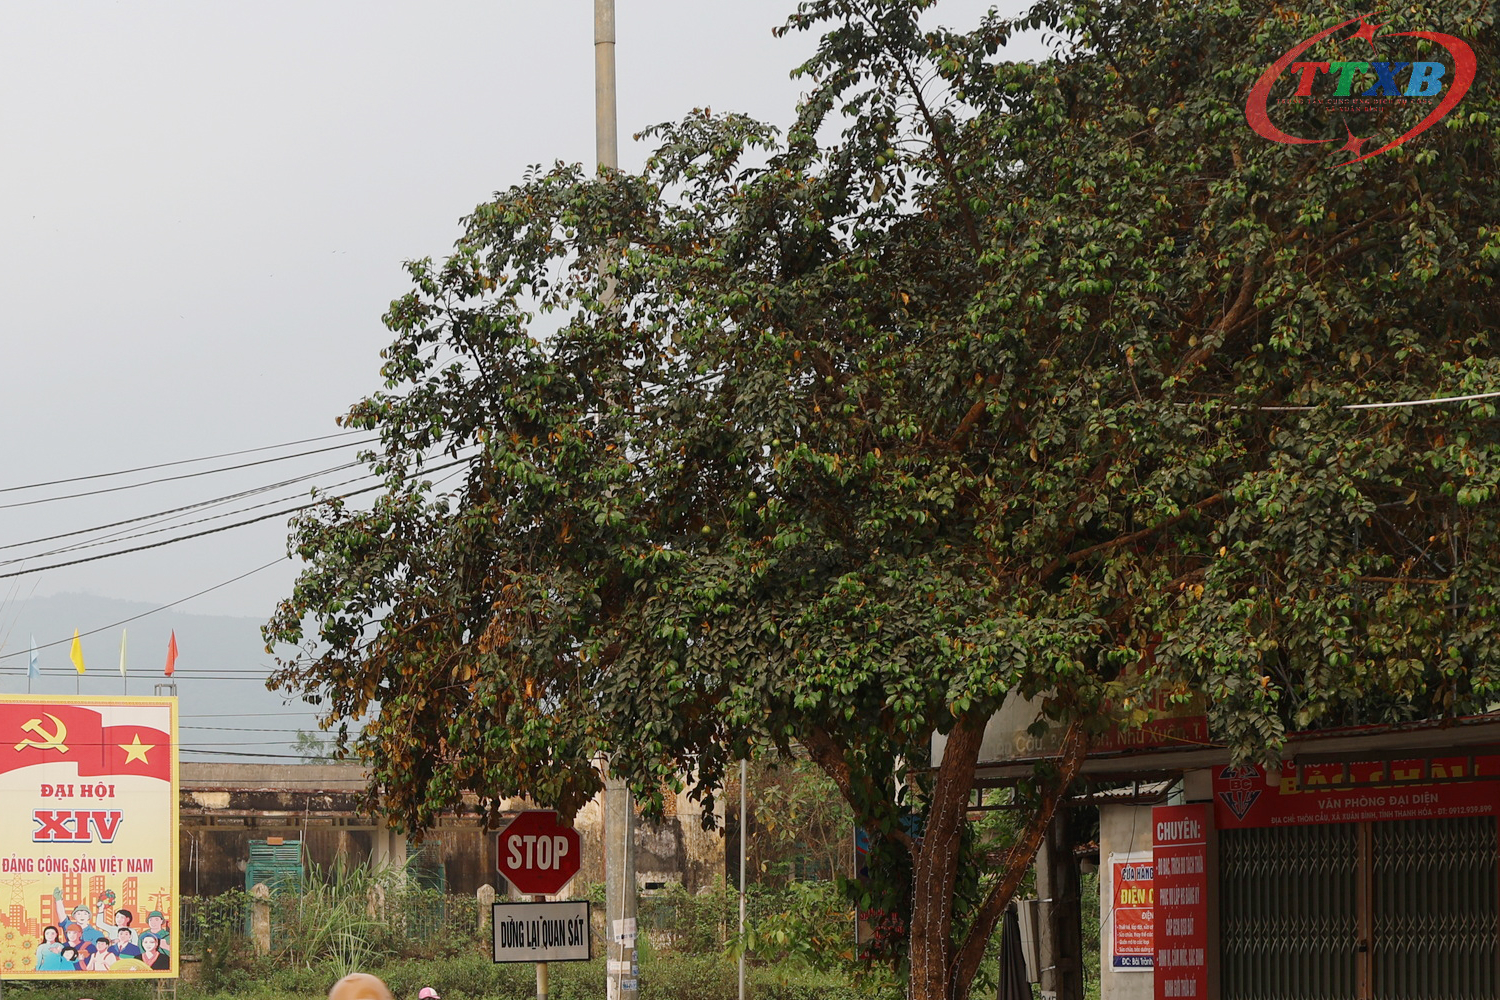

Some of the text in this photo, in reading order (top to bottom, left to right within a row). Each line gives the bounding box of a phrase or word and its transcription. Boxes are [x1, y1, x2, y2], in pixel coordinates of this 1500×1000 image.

[40, 782, 115, 801] ĐẠI HỘI
[1230, 779, 1252, 790] BC
[1279, 771, 1356, 795] BẢO
[1317, 791, 1439, 809] VĂN PHÒNG ĐẠI DIỆN
[33, 809, 122, 842] XIV
[1271, 816, 1282, 825] ĐỊA
[1297, 813, 1313, 823] THÔN
[1342, 811, 1359, 820] XUÂN
[1395, 809, 1416, 817] THANH
[1418, 807, 1432, 816] HÓA
[1157, 817, 1201, 841] CHUYÊN:
[507, 834, 569, 870] STOP
[2, 854, 153, 876] ĐẢNG CỘNG SẢN VIỆT NAM
[1121, 864, 1135, 880] CỬA
[1121, 886, 1145, 907] ĐIỆN
[501, 915, 584, 949] DỪNG LẠI QUAN SÁT
